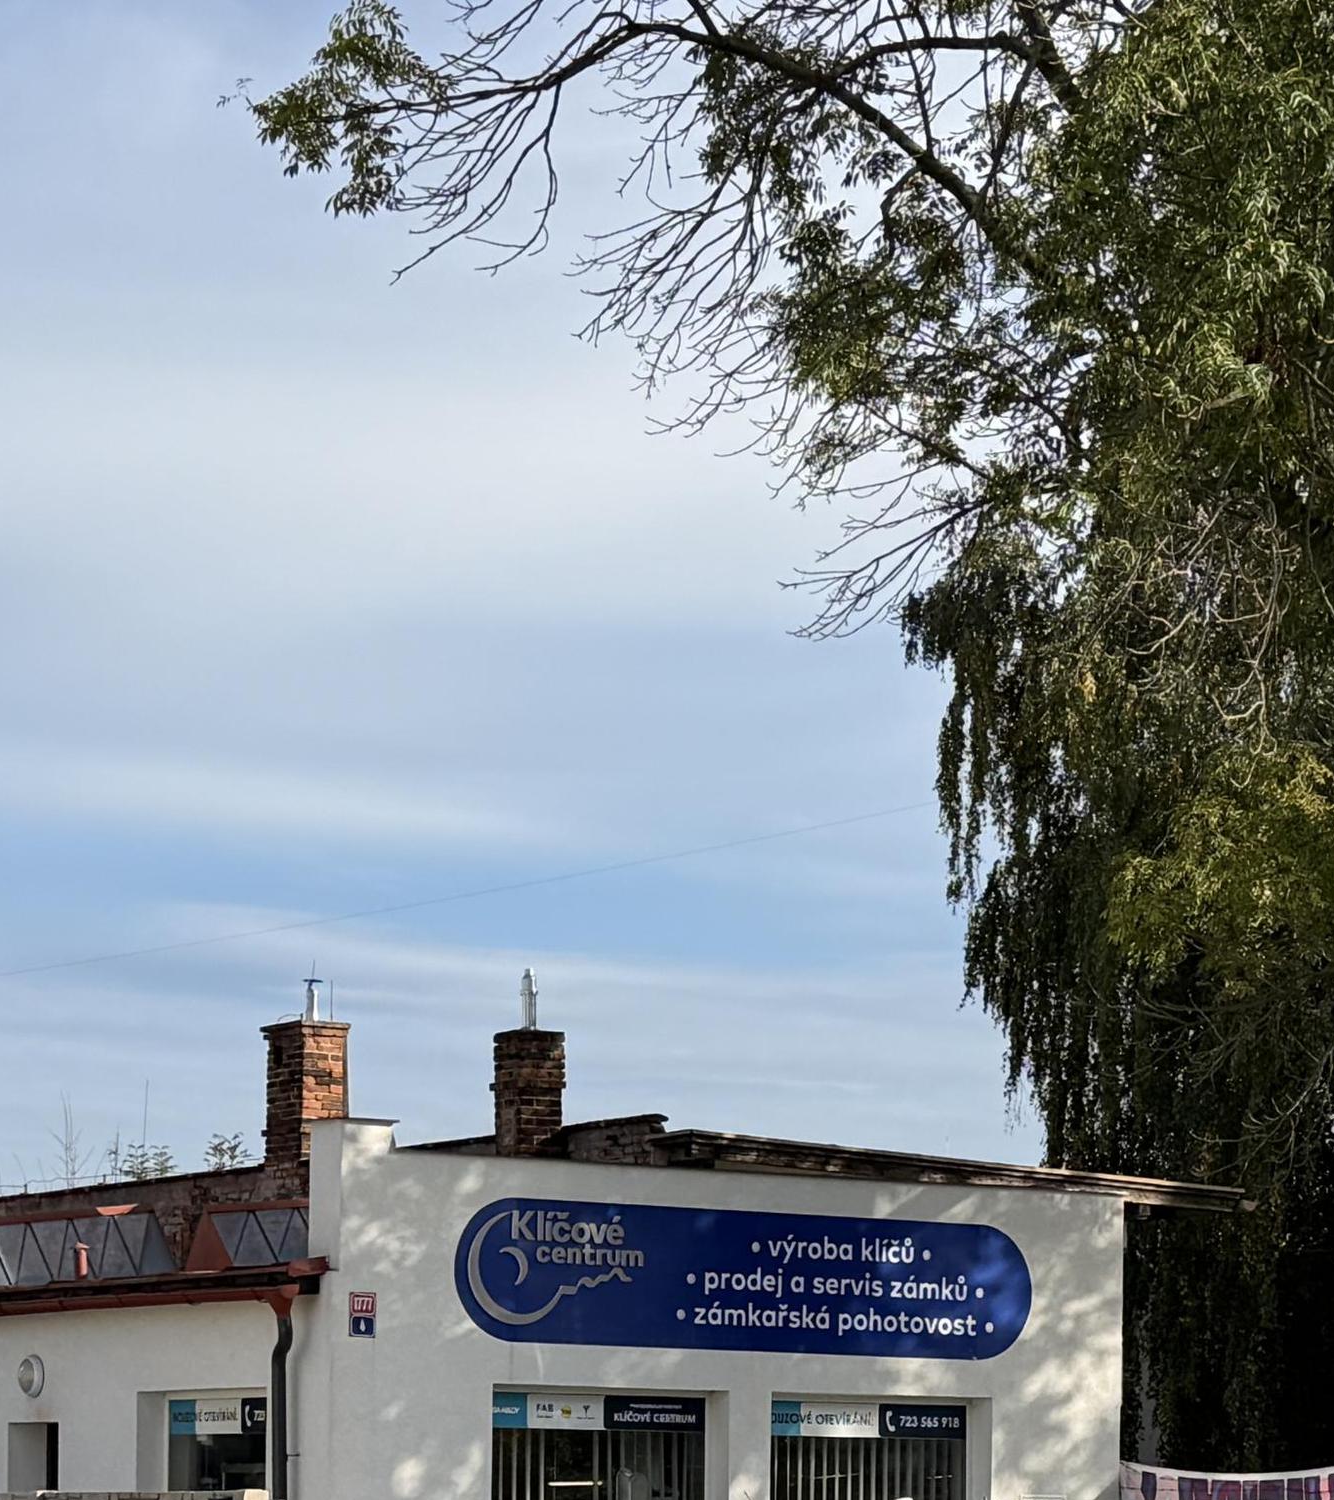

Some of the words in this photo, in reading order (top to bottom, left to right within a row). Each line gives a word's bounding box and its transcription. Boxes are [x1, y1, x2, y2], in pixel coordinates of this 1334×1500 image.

[510, 1209, 625, 1245] Klíčové
[535, 1244, 644, 1267] centrum
[768, 1235, 854, 1264] výroba
[861, 1238, 915, 1263] klíčů
[704, 1267, 784, 1298] prodej
[790, 1274, 805, 1291] a
[812, 1273, 884, 1297] servis
[890, 1275, 967, 1301] zámků
[693, 1302, 830, 1329] zámkařská
[837, 1309, 977, 1337] pohotovost
[653, 1412, 696, 1423] CENTRUM
[899, 1415, 917, 1427] 723
[921, 1416, 939, 1428] 565
[942, 1416, 960, 1428] 918
